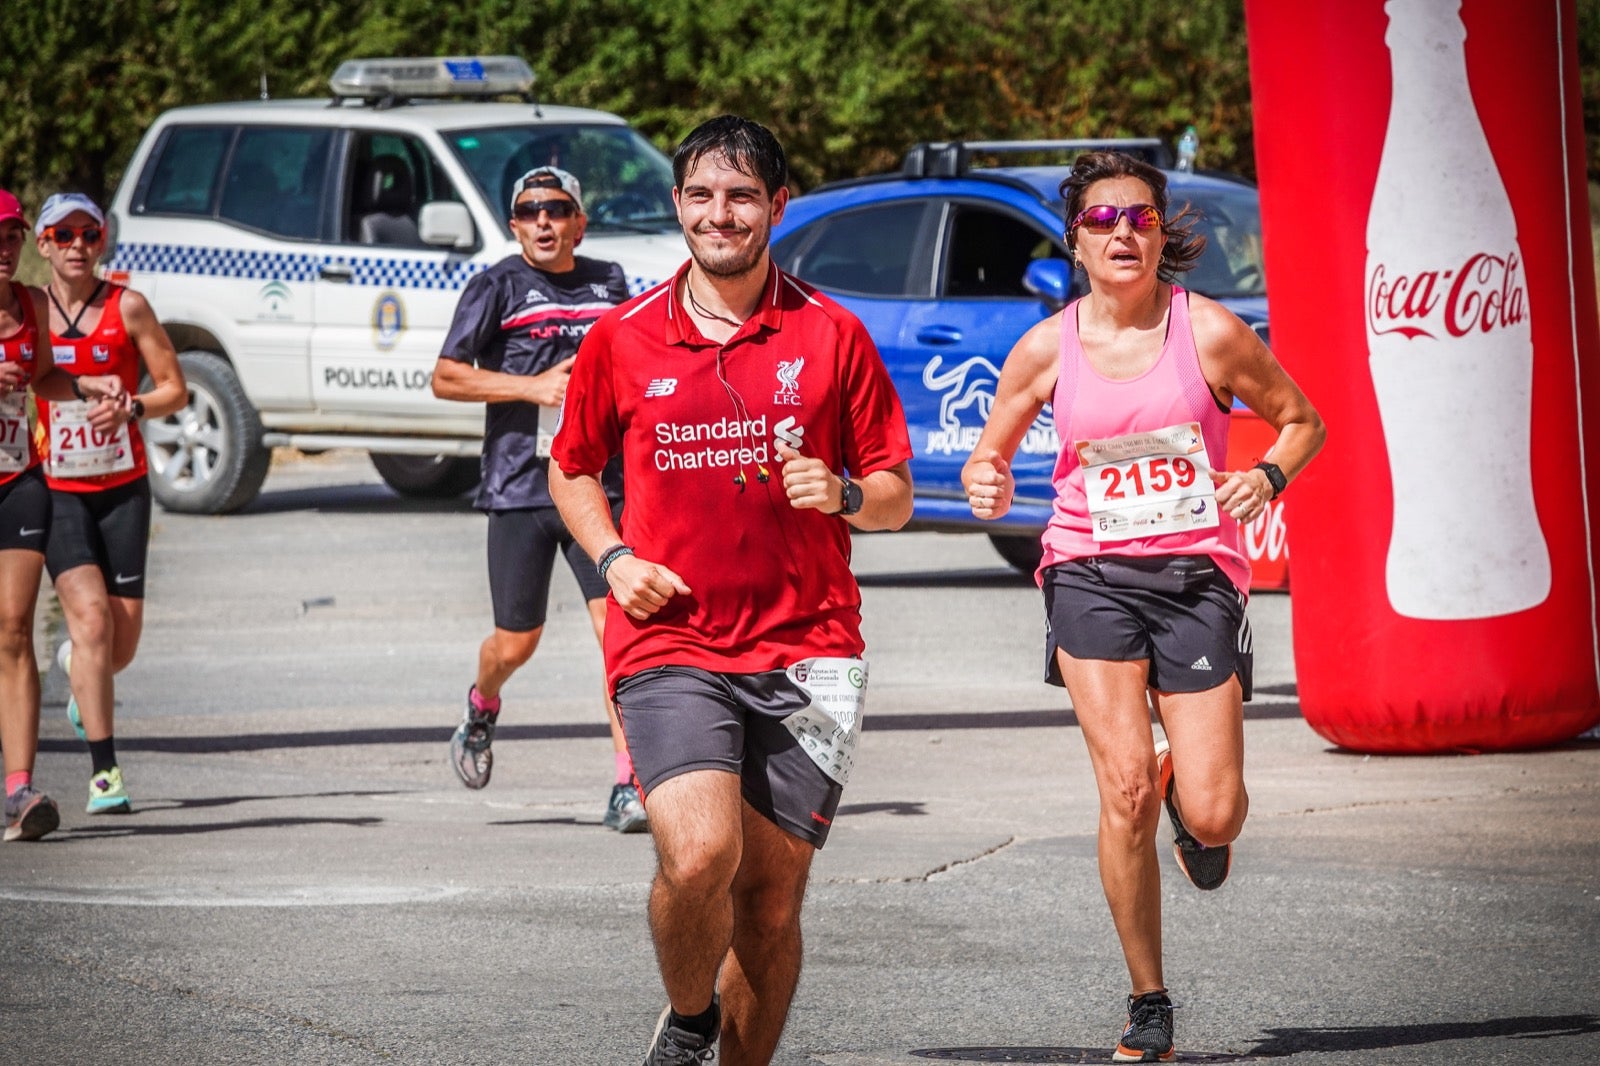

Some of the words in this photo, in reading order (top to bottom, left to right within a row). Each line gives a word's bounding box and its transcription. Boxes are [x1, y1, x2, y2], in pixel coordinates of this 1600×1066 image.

[1369, 251, 1523, 341] Coca-Cola
[325, 367, 398, 389] POLICIA
[655, 414, 767, 444] Standard
[654, 442, 769, 471] Chartered
[1100, 456, 1196, 501] 2159
